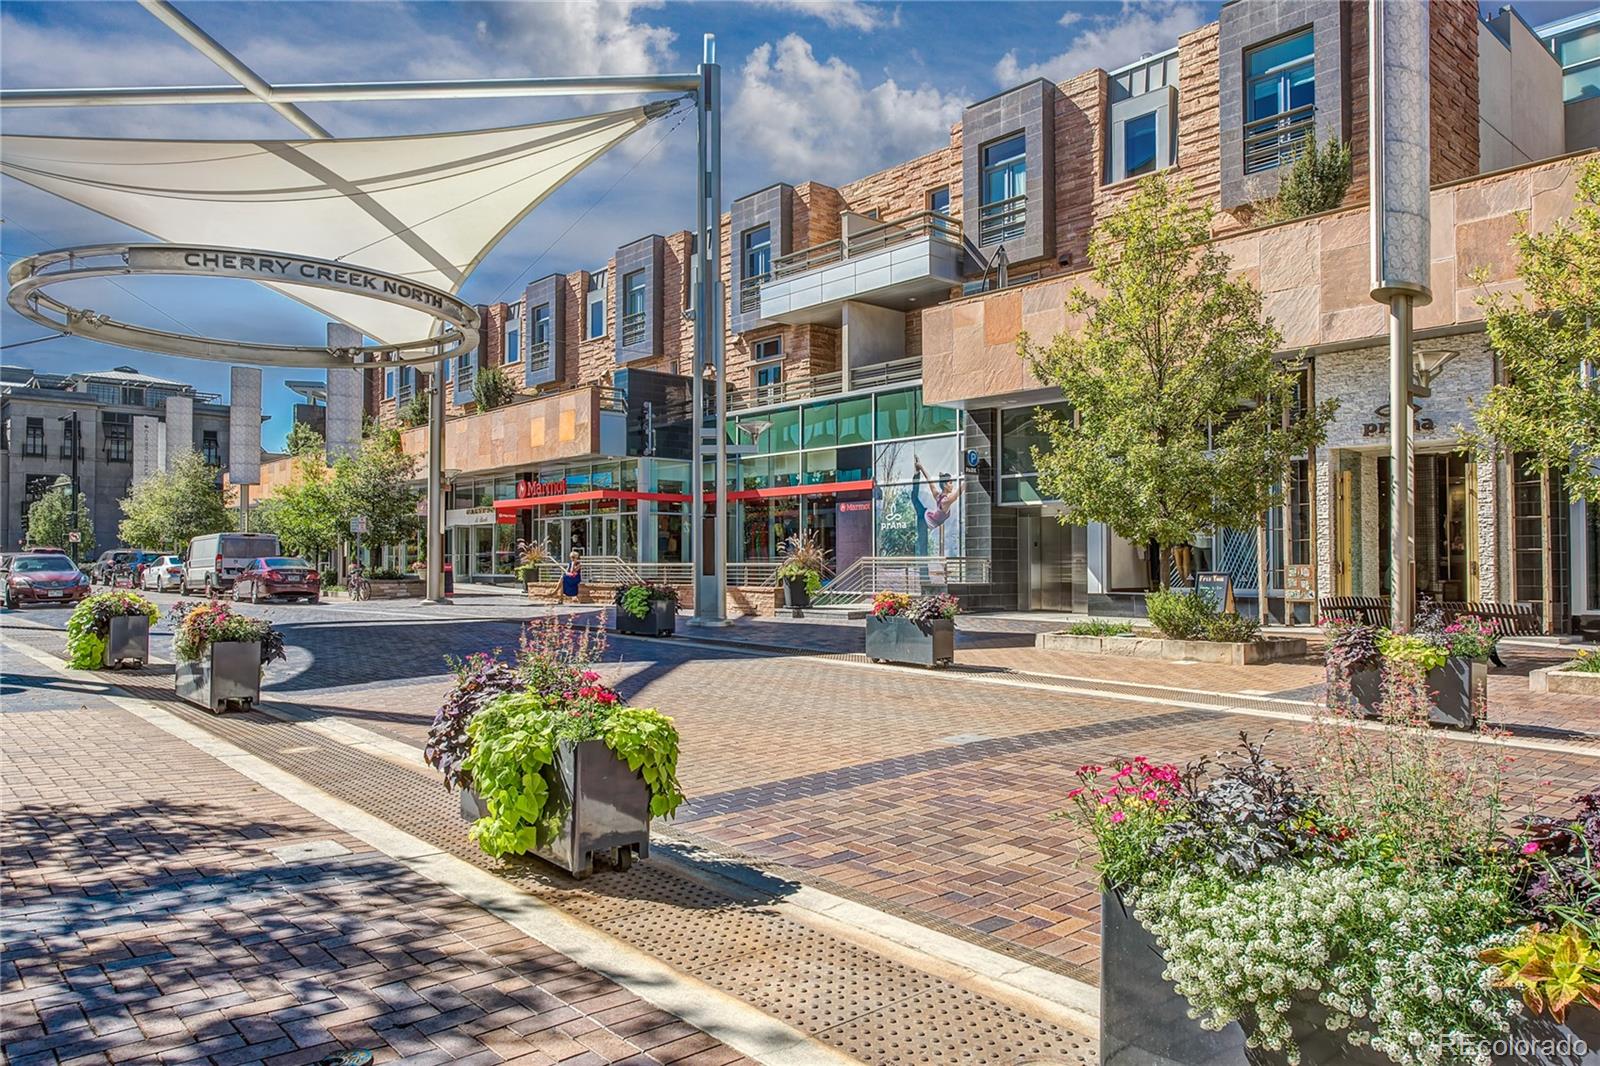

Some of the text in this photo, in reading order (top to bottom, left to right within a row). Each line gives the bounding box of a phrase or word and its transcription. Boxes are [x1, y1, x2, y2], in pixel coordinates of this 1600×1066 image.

[184, 253, 443, 309] CHERRY CREEK NORTH
[1362, 418, 1435, 437] prna
[527, 480, 567, 497] Marmot
[846, 503, 871, 511] Marmot
[880, 521, 907, 531] prAna
